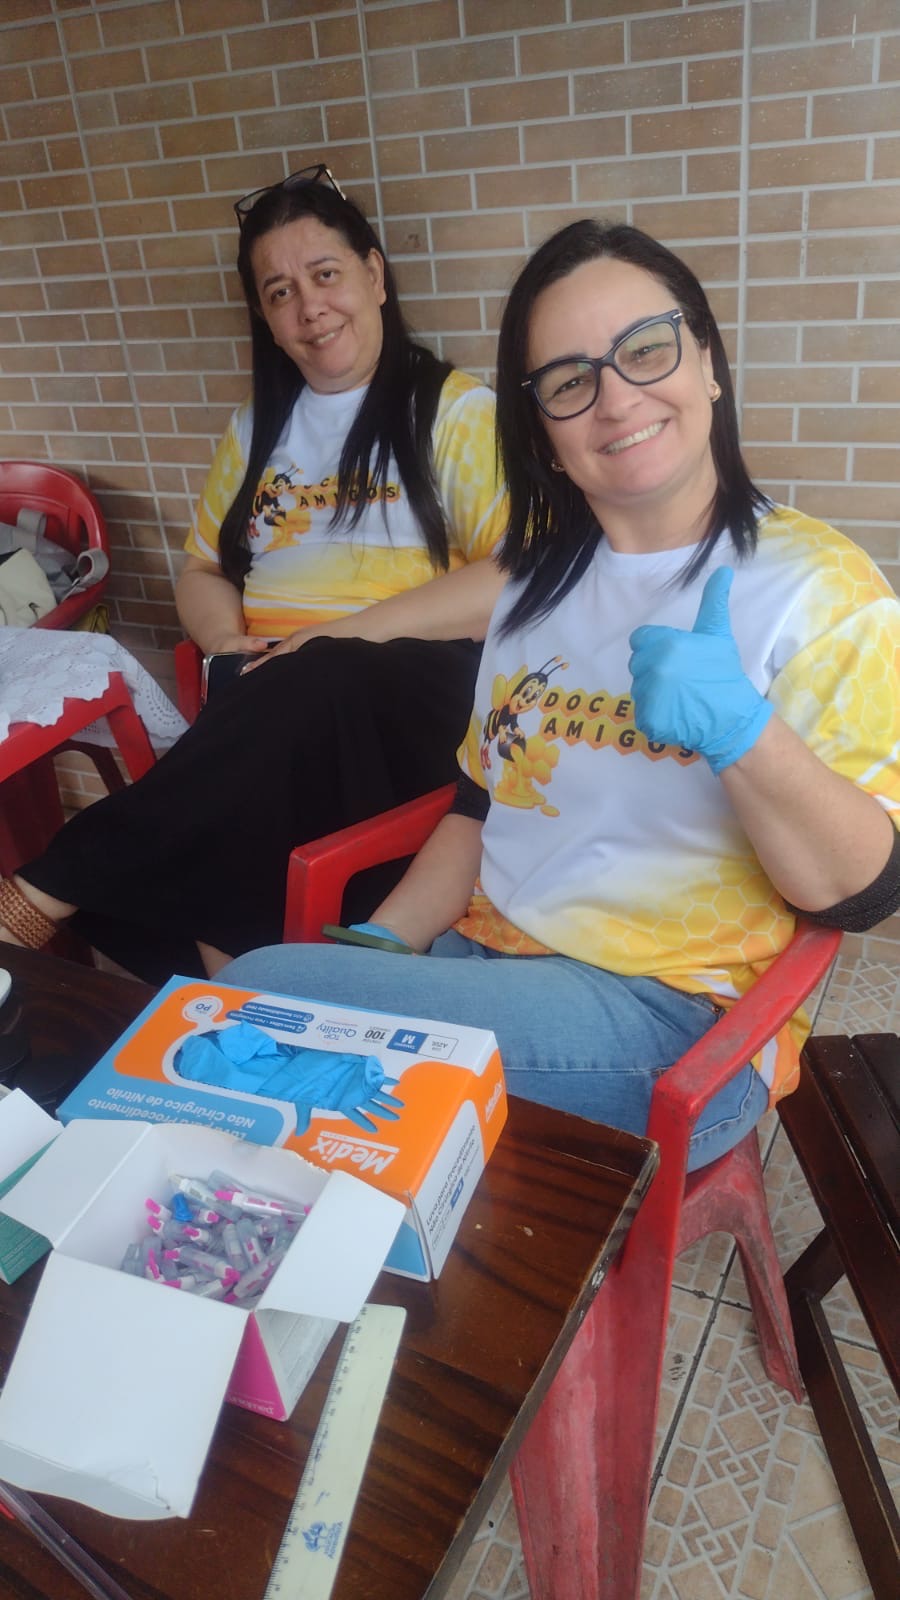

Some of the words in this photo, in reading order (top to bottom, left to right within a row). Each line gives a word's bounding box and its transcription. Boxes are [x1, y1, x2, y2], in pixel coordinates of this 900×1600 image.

[316, 1023, 357, 1038] Quality
[365, 1029, 386, 1040] 100
[402, 1034, 416, 1045] M
[107, 1087, 145, 1101] Nitrilo
[146, 1095, 165, 1106] de
[88, 1098, 178, 1124] Procedimento
[228, 1114, 256, 1129] Não
[308, 1136, 396, 1175] Medix
